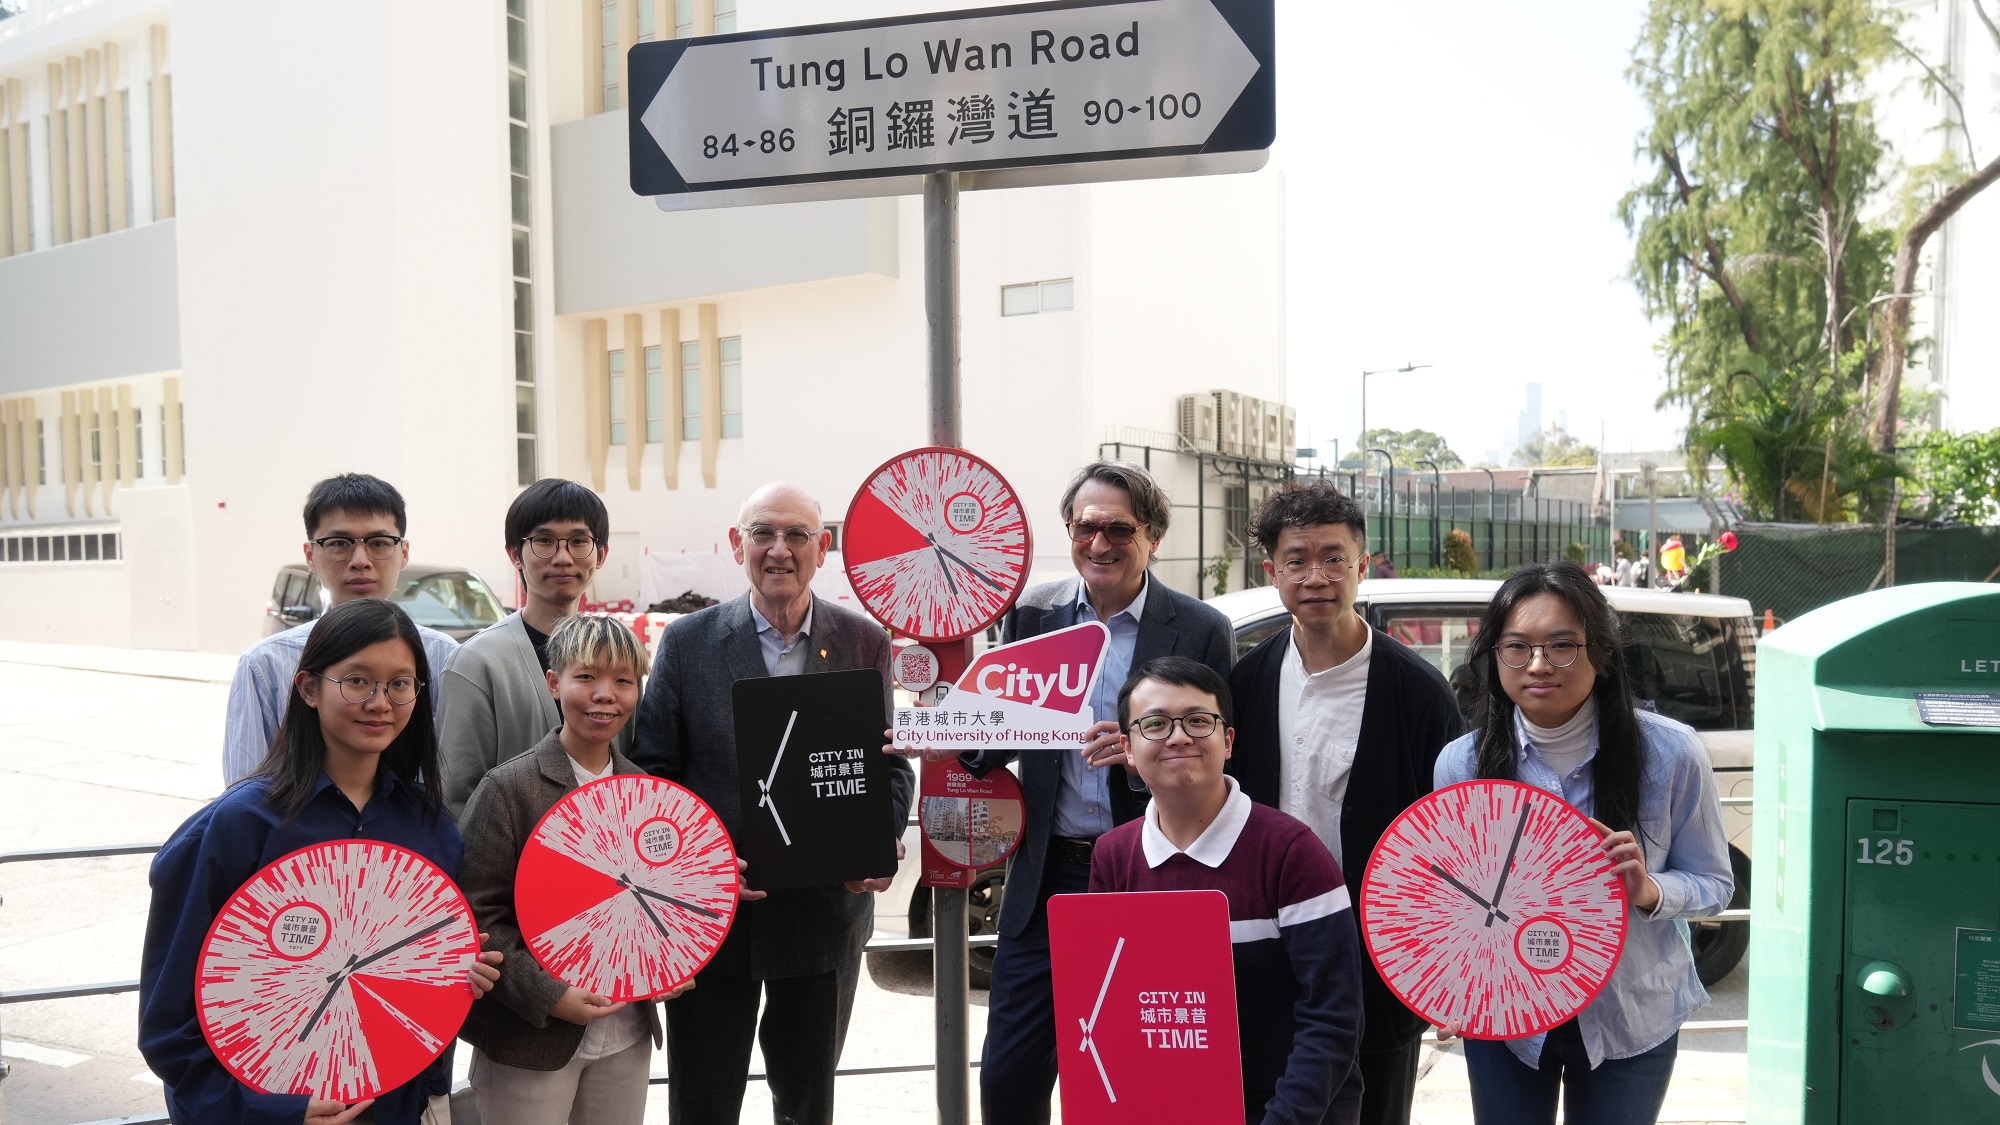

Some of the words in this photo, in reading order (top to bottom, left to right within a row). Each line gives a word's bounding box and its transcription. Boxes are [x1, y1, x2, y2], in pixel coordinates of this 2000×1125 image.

[750, 56, 845, 92] Tung
[863, 46, 908, 81] Lo
[923, 37, 1012, 75] Wan
[1030, 21, 1139, 65] Road
[827, 87, 1059, 157] 銅鑼灣道
[953, 514, 976, 522] TIME
[1960, 659, 2000, 673] LET
[976, 663, 1089, 707] CityU
[896, 710, 1006, 727] 香港城市大學
[896, 729, 924, 744] City
[926, 729, 993, 745] University
[995, 729, 1012, 742] of
[1013, 729, 1050, 744] Hong
[1052, 729, 1088, 744] Kong
[808, 750, 843, 763] CITY
[846, 748, 864, 760] IN
[810, 761, 865, 779] 城市景昔
[946, 773, 972, 782] 1959
[811, 778, 867, 798] TIME
[643, 829, 660, 838] CITY
[645, 841, 673, 853] TIME
[1856, 837, 1914, 866] 125
[284, 915, 307, 923] CITY
[307, 917, 320, 925] IN
[280, 932, 316, 945] TIME
[1527, 947, 1560, 958] TIME
[1138, 991, 1180, 1004] CITY
[1184, 991, 1206, 1004] IN
[1140, 1007, 1207, 1024] 城市景昔
[1141, 1028, 1209, 1049] TIME
